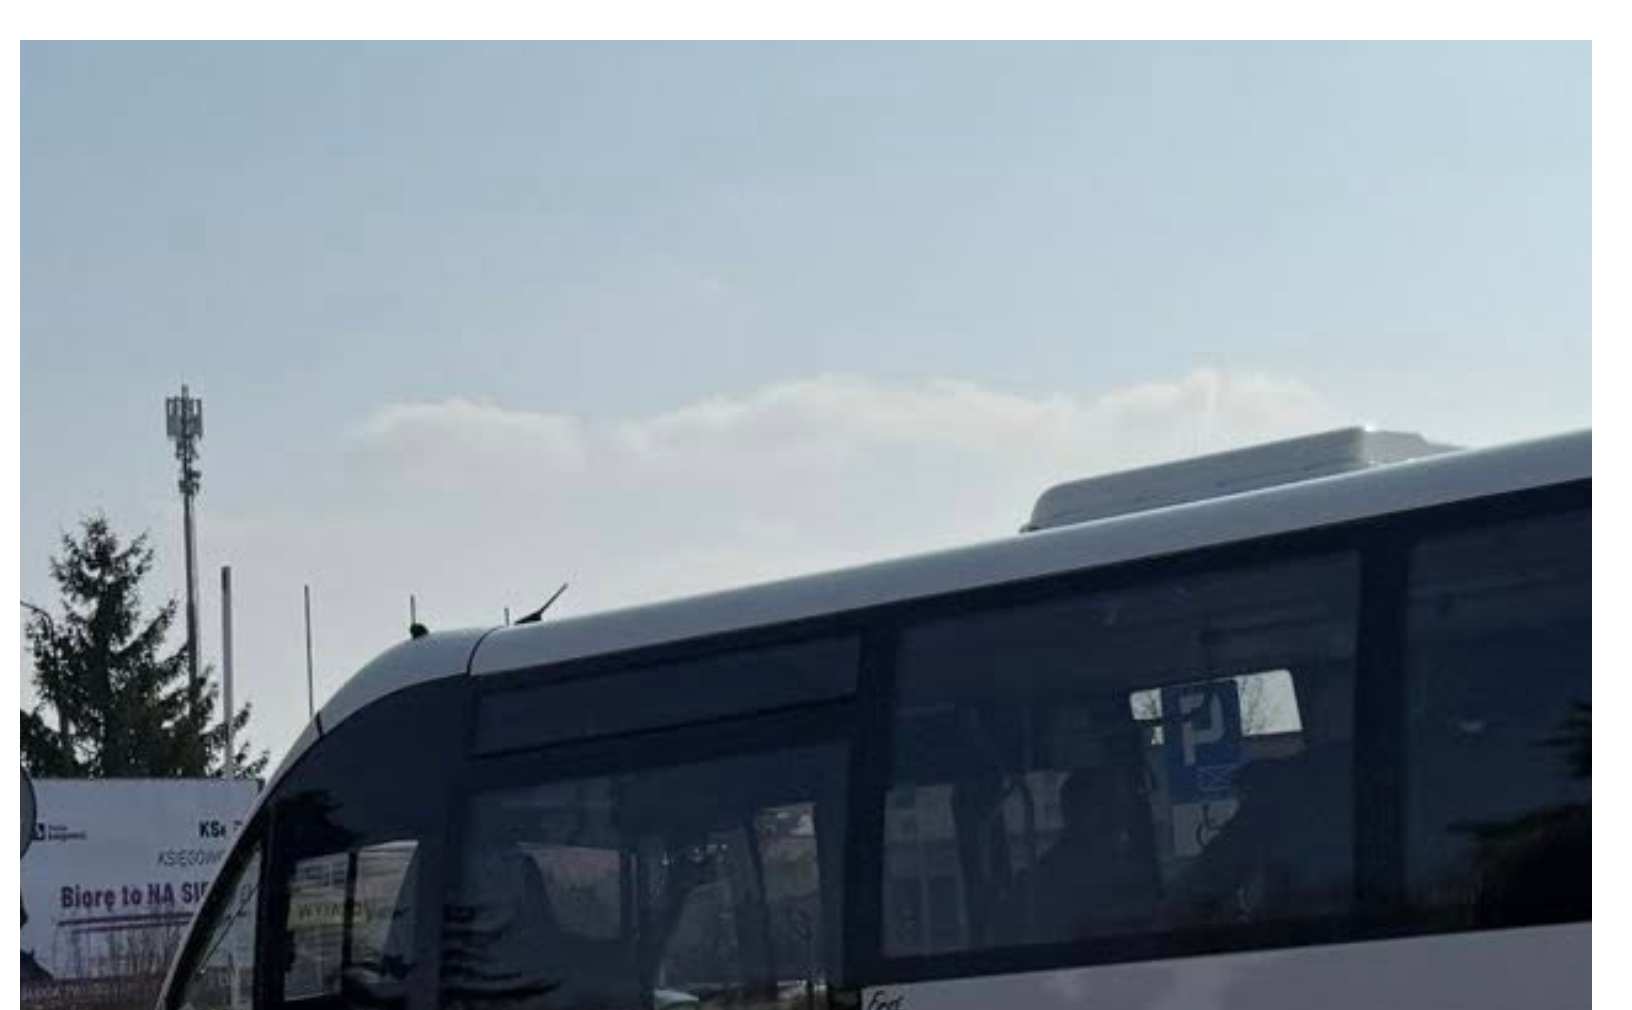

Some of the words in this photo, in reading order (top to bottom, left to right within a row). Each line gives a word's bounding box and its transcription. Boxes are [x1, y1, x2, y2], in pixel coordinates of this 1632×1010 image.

[61, 884, 116, 912] Biorę
[122, 885, 142, 906] to
[147, 881, 175, 905] NA
